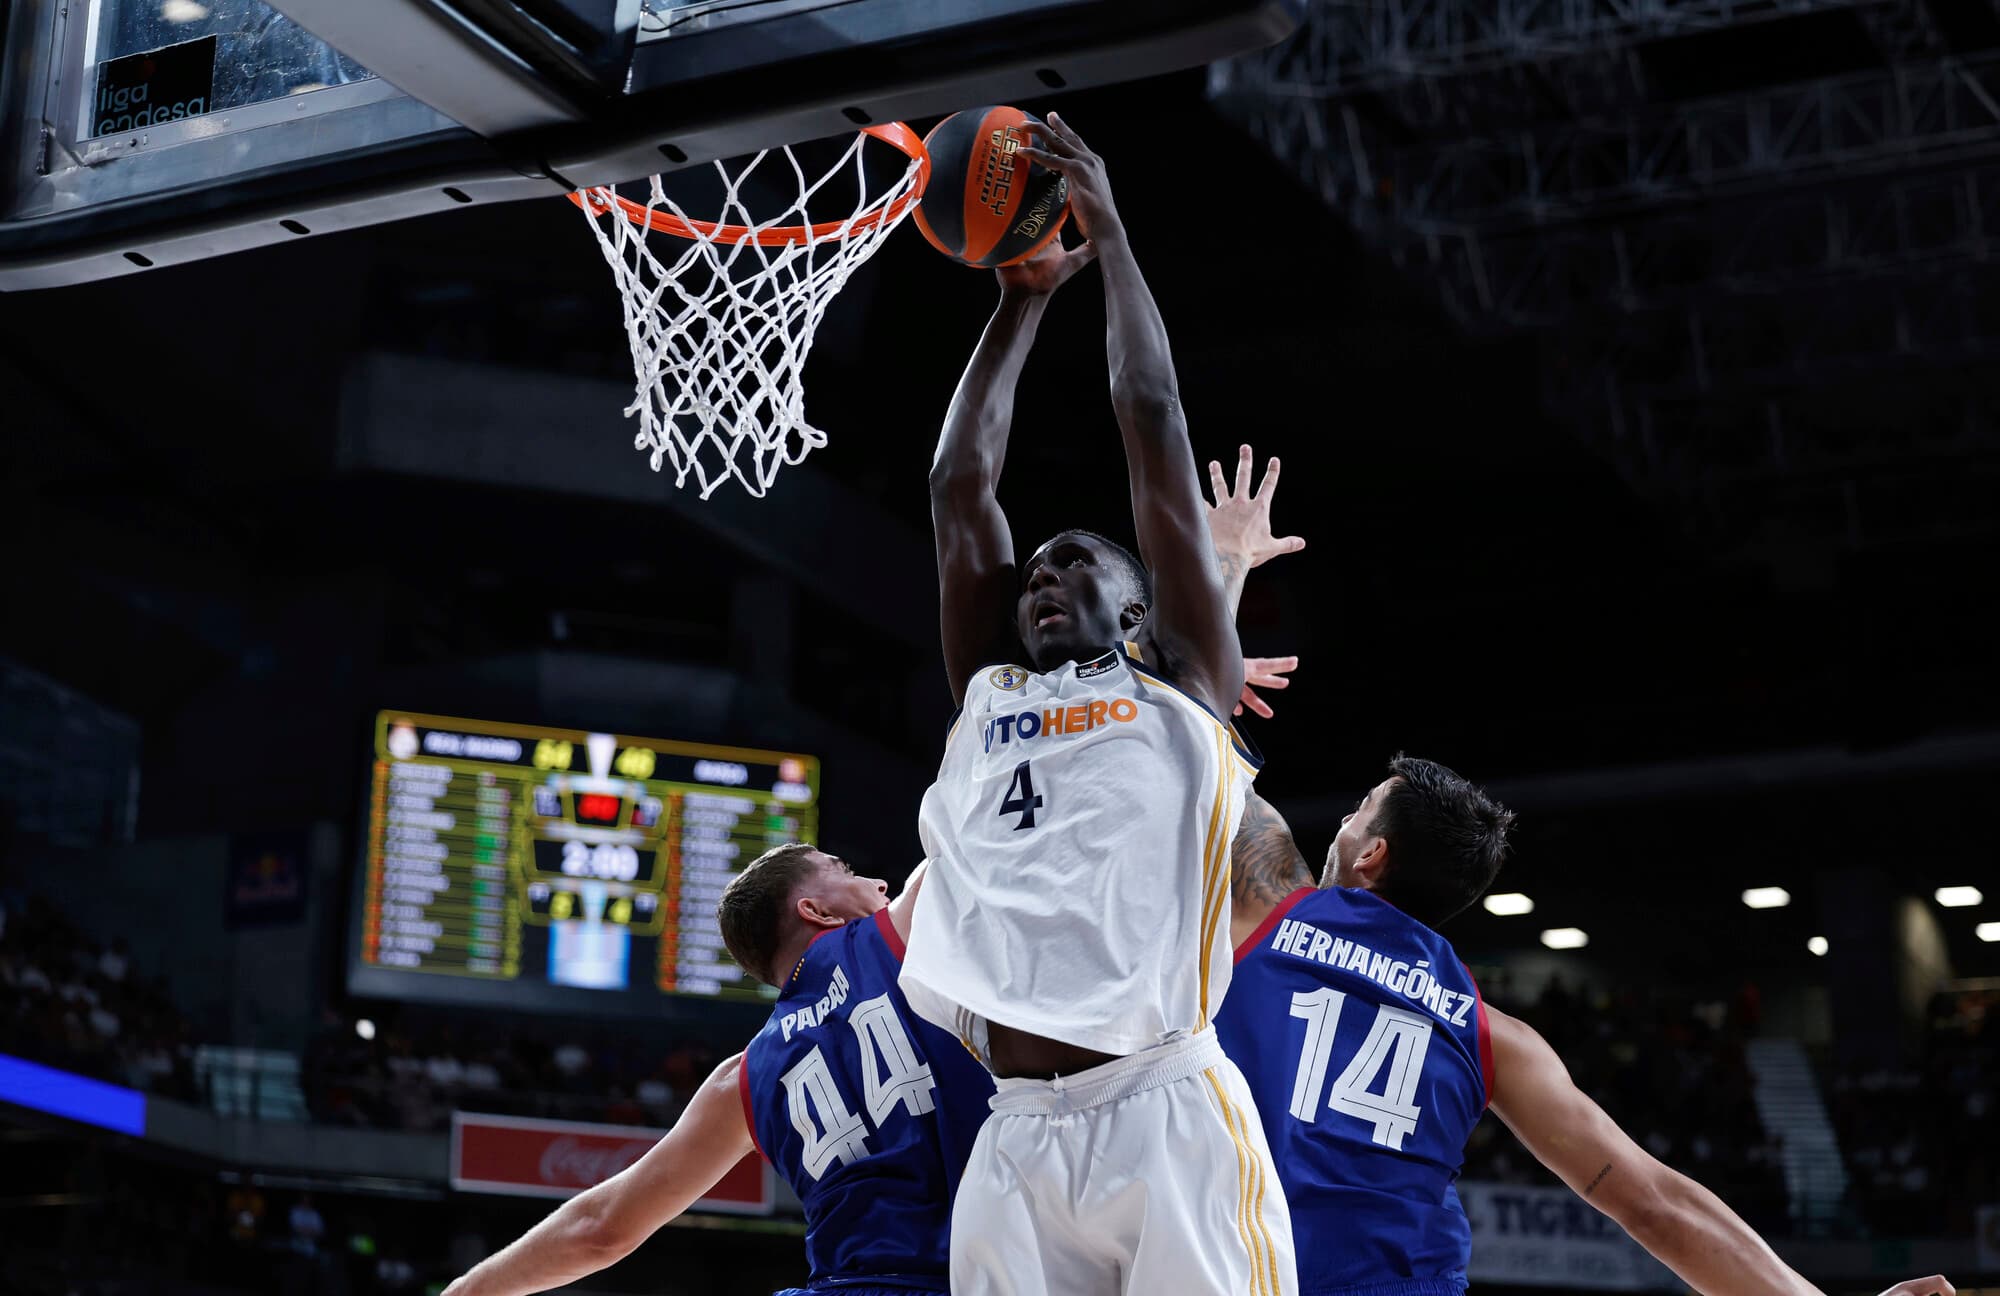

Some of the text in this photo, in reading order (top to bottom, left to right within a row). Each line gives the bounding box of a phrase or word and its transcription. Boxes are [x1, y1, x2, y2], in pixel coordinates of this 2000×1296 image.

[98, 96, 205, 136] endesa
[101, 82, 148, 112] liga
[988, 125, 1021, 217] LEGACY
[998, 759, 1043, 831] 4
[780, 964, 850, 1043] PARRA
[1270, 918, 1475, 1028] HERNANGÓMEZ
[778, 991, 937, 1182] 44
[1288, 986, 1434, 1152] 14
